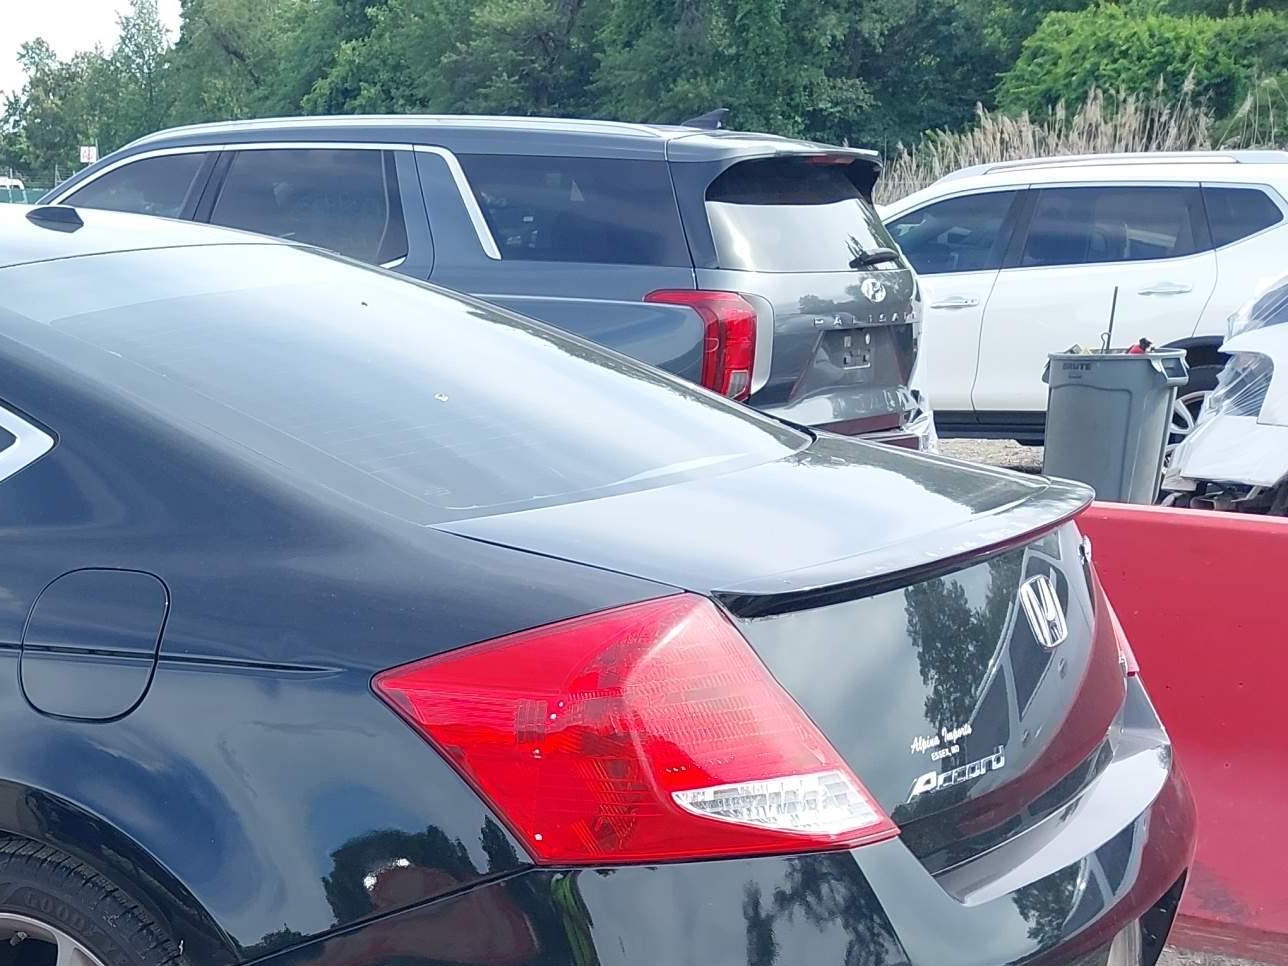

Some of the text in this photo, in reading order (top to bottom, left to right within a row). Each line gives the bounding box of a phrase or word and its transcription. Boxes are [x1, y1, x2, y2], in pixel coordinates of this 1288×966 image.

[910, 723, 972, 754] Alpine Imports
[906, 744, 1006, 804] Accord
